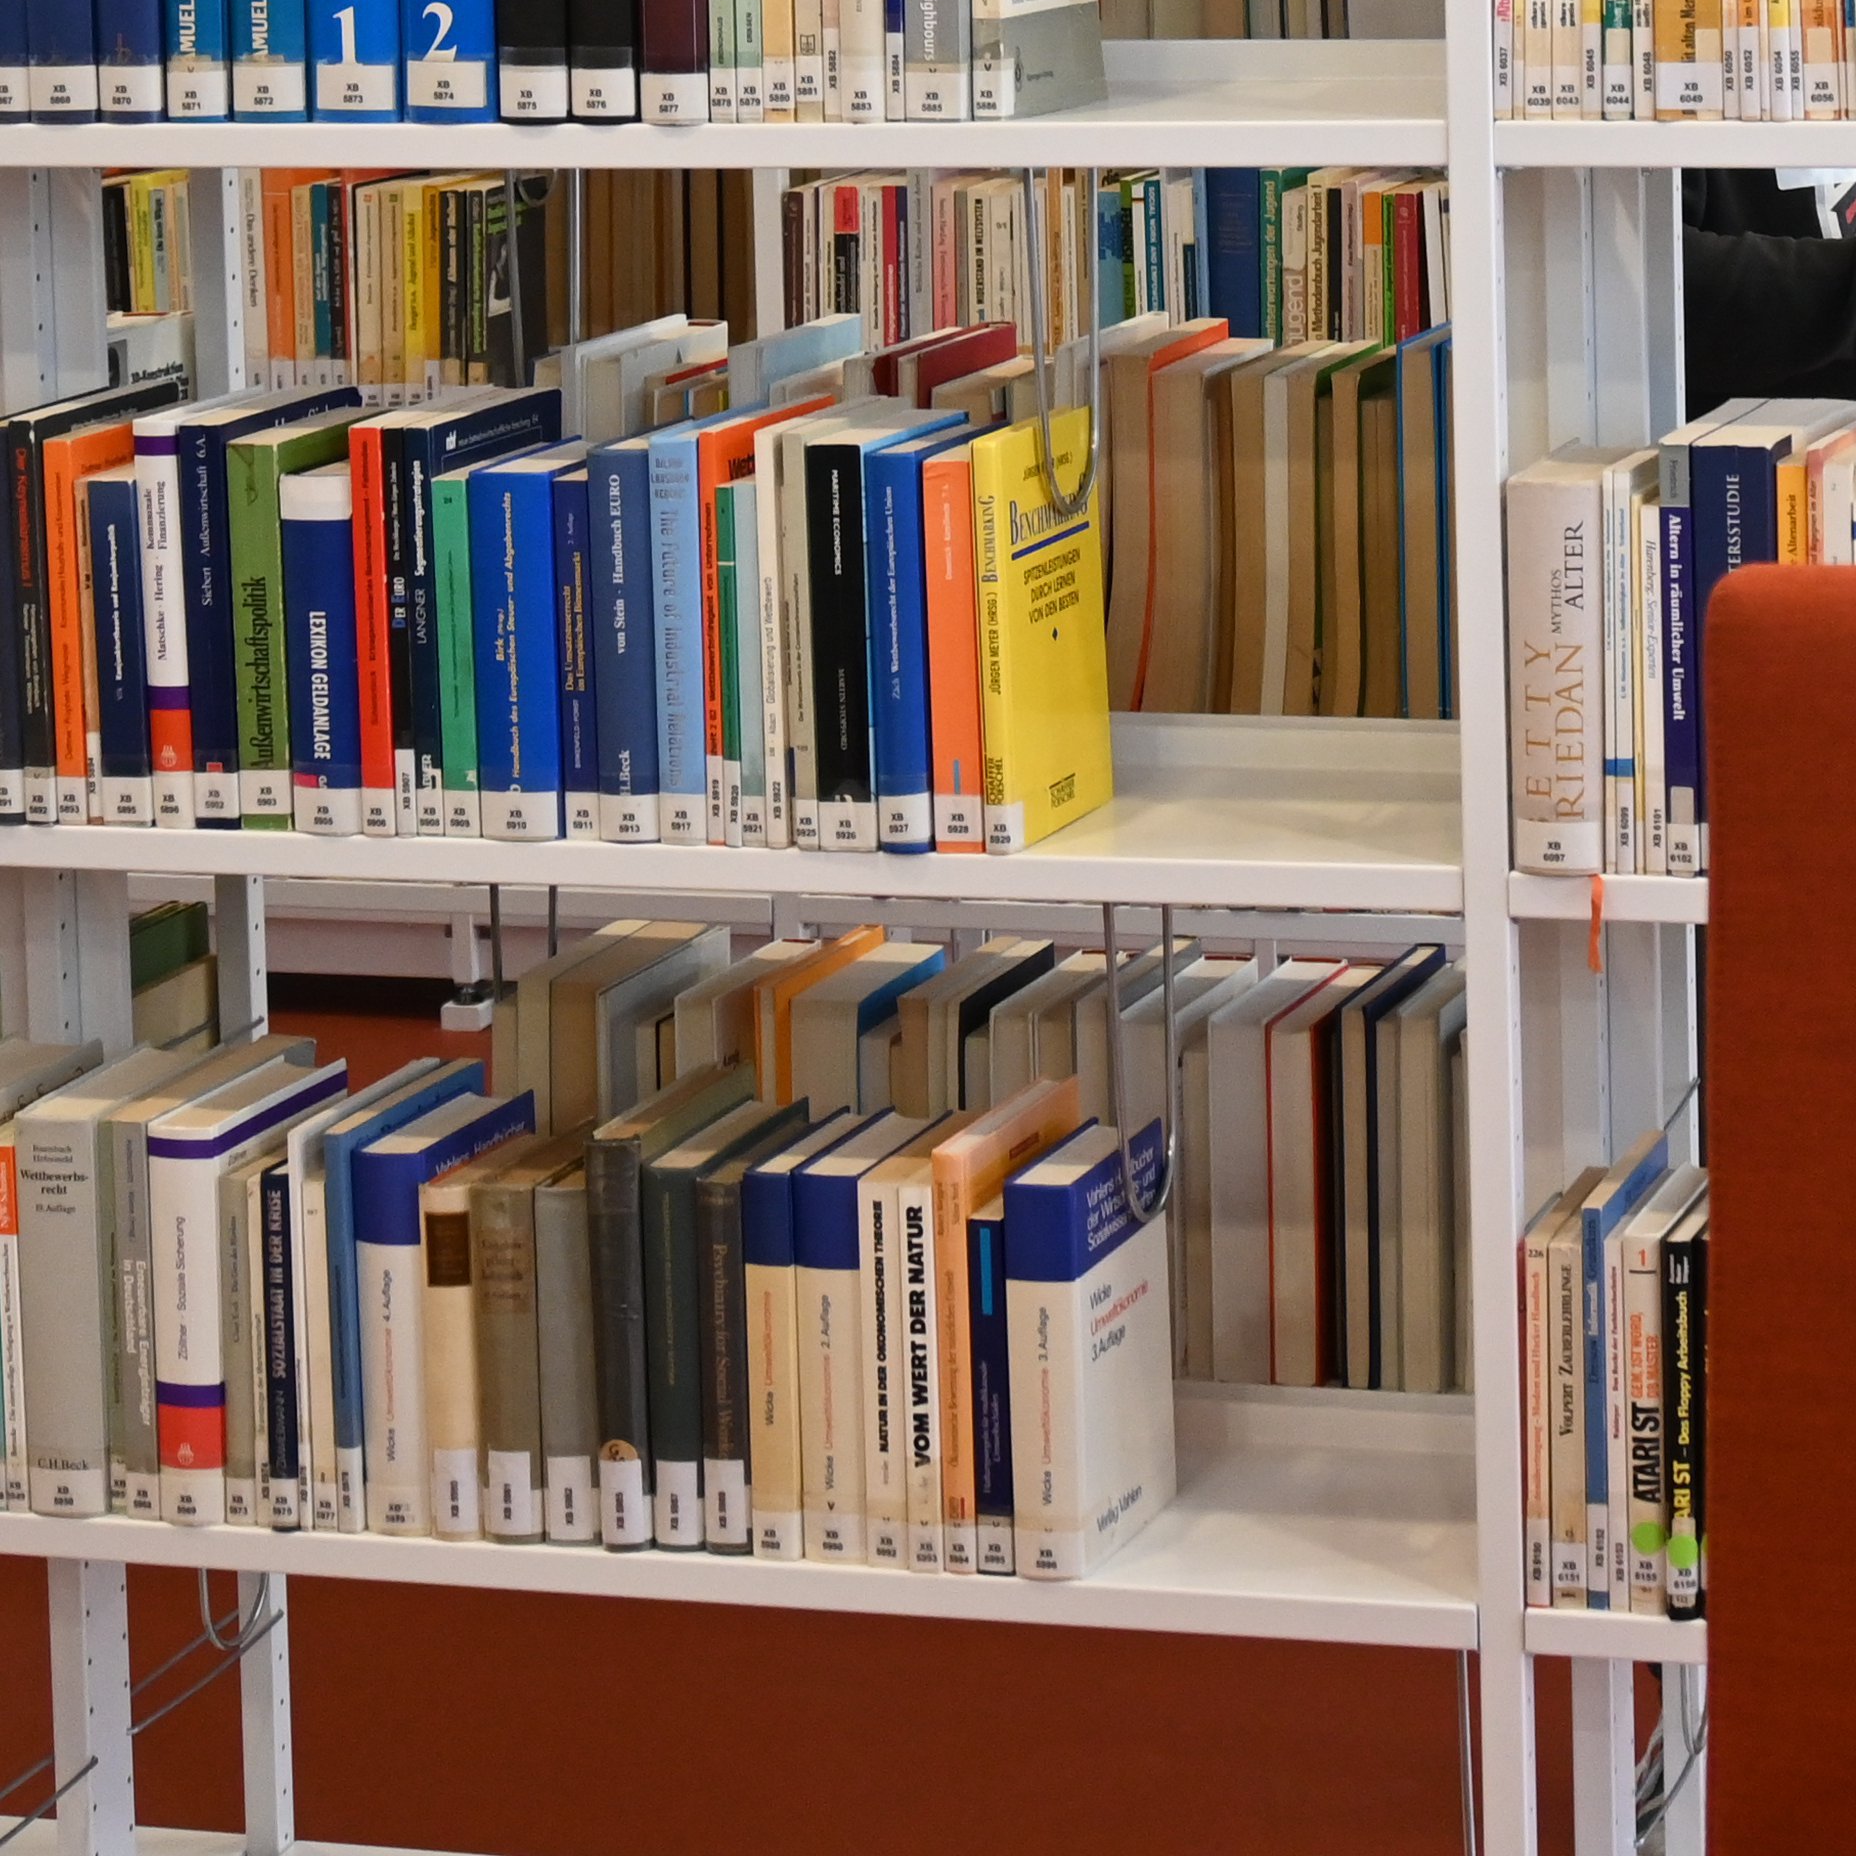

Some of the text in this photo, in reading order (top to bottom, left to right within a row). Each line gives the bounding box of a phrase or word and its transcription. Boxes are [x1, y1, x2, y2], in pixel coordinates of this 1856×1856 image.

[437, 81, 450, 89] XB
[1668, 514, 1679, 560] Altern
[608, 474, 626, 655] von Stein Handbuch EURO
[1551, 520, 1584, 634] MYTHOS ALTER
[1670, 564, 1680, 579] in
[155, 564, 168, 661] Matschke Hering
[417, 587, 428, 644] LANGNER
[308, 610, 330, 760] LEXIKON GELDANLAGE
[1672, 667, 1686, 721] Umwelt
[40, 1184, 68, 1196] recht
[906, 1205, 930, 1468] VOM WERT DER NATUR
[1678, 1373, 1690, 1423] Floppy
[1631, 1402, 1661, 1504] ATARI ST
[1679, 1426, 1690, 1445] Das
[1673, 1460, 1691, 1485] ST
